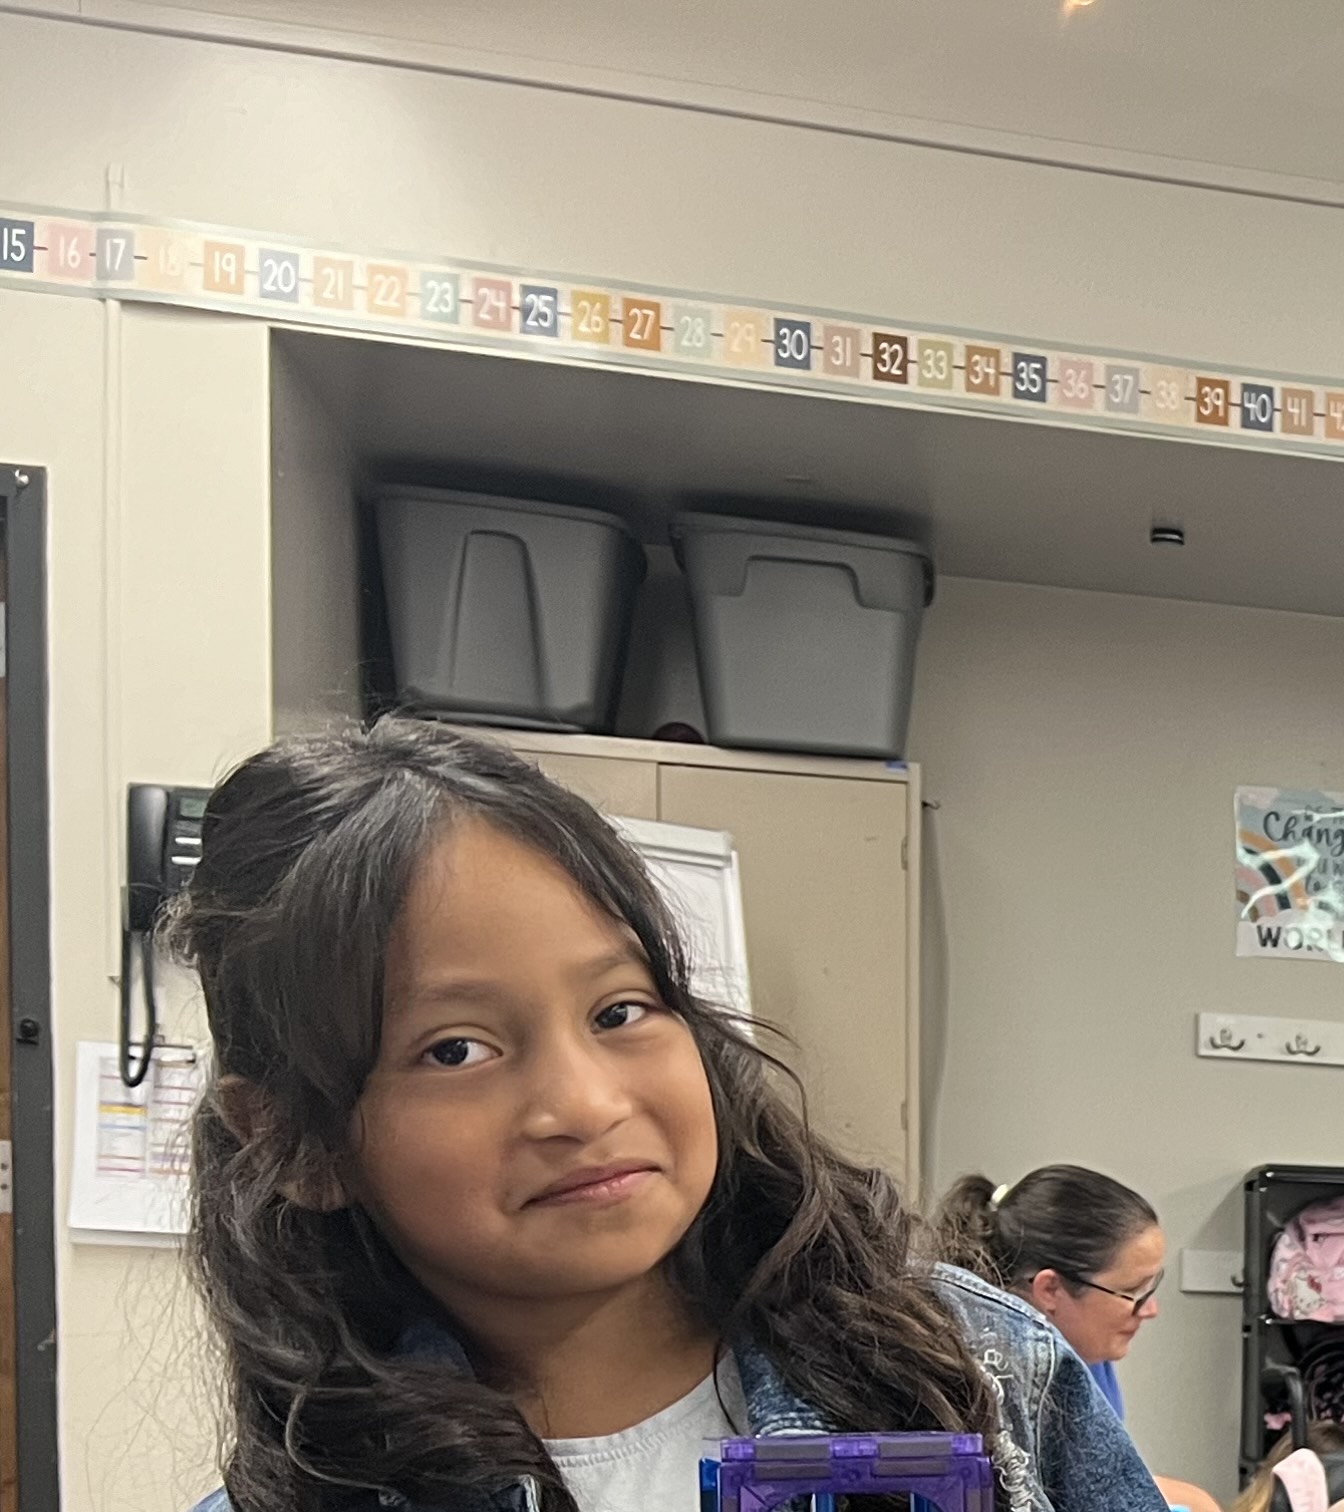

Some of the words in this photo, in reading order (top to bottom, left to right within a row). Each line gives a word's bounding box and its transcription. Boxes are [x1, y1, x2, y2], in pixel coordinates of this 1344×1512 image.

[3, 227, 26, 261] 15
[59, 237, 81, 268] 16
[106, 238, 126, 271] 17
[214, 252, 236, 285] 19
[264, 260, 295, 293] 20
[322, 267, 343, 300] 21
[373, 275, 400, 307] 22
[426, 280, 452, 313] 23
[478, 288, 506, 321] 24
[526, 294, 554, 327] 25
[578, 301, 601, 333] 26
[628, 308, 654, 340] 27
[681, 316, 704, 347] 28
[730, 322, 756, 354] 29
[777, 328, 809, 359] 30
[831, 335, 850, 367] 31
[877, 342, 904, 375] 32
[923, 349, 946, 379] 33
[969, 355, 996, 386] 34
[1015, 362, 1042, 392] 35
[1062, 369, 1089, 399] 36
[1110, 374, 1133, 404] 37
[1200, 386, 1225, 417] 39
[1244, 392, 1272, 423] 40
[1286, 398, 1306, 427] 41
